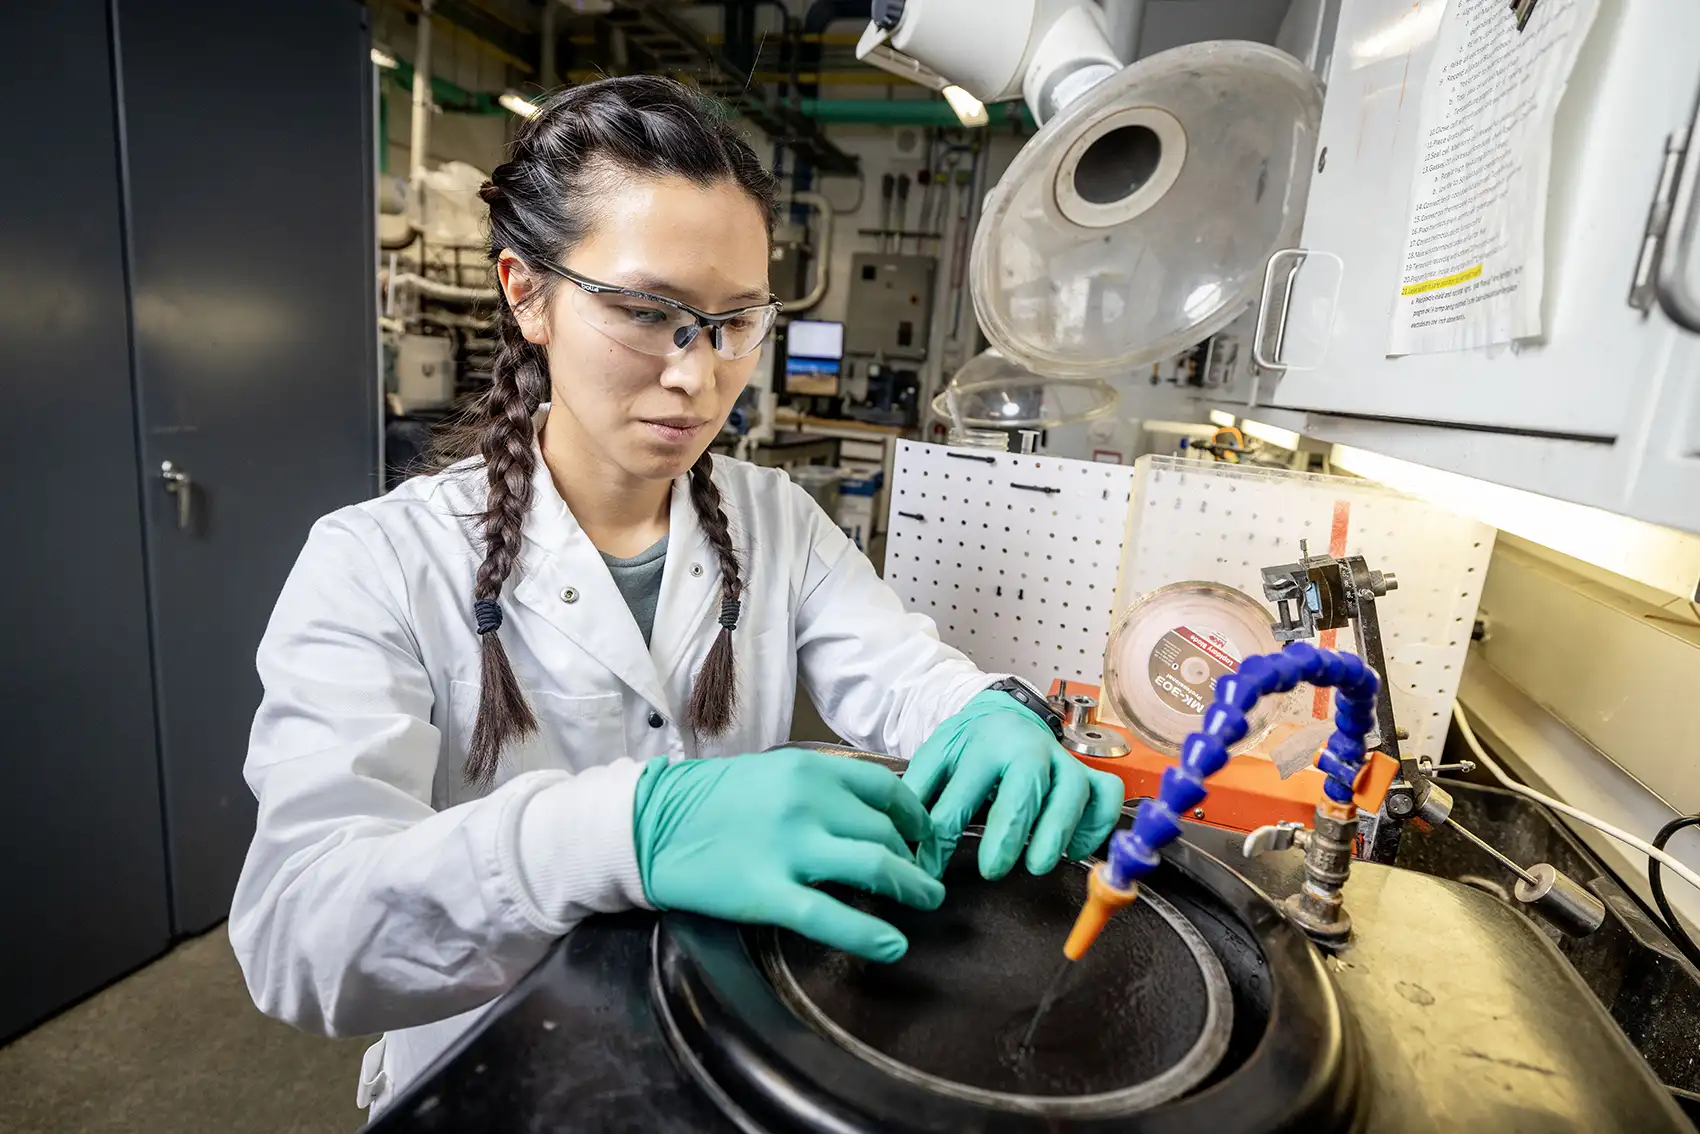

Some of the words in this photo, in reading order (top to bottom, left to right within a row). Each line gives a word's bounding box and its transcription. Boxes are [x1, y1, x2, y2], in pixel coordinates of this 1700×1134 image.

[1190, 635, 1208, 649] Blade
[1208, 646, 1234, 667] Lapidary
[1155, 675, 1204, 713] MK-303
[1165, 673, 1203, 701] Professional
